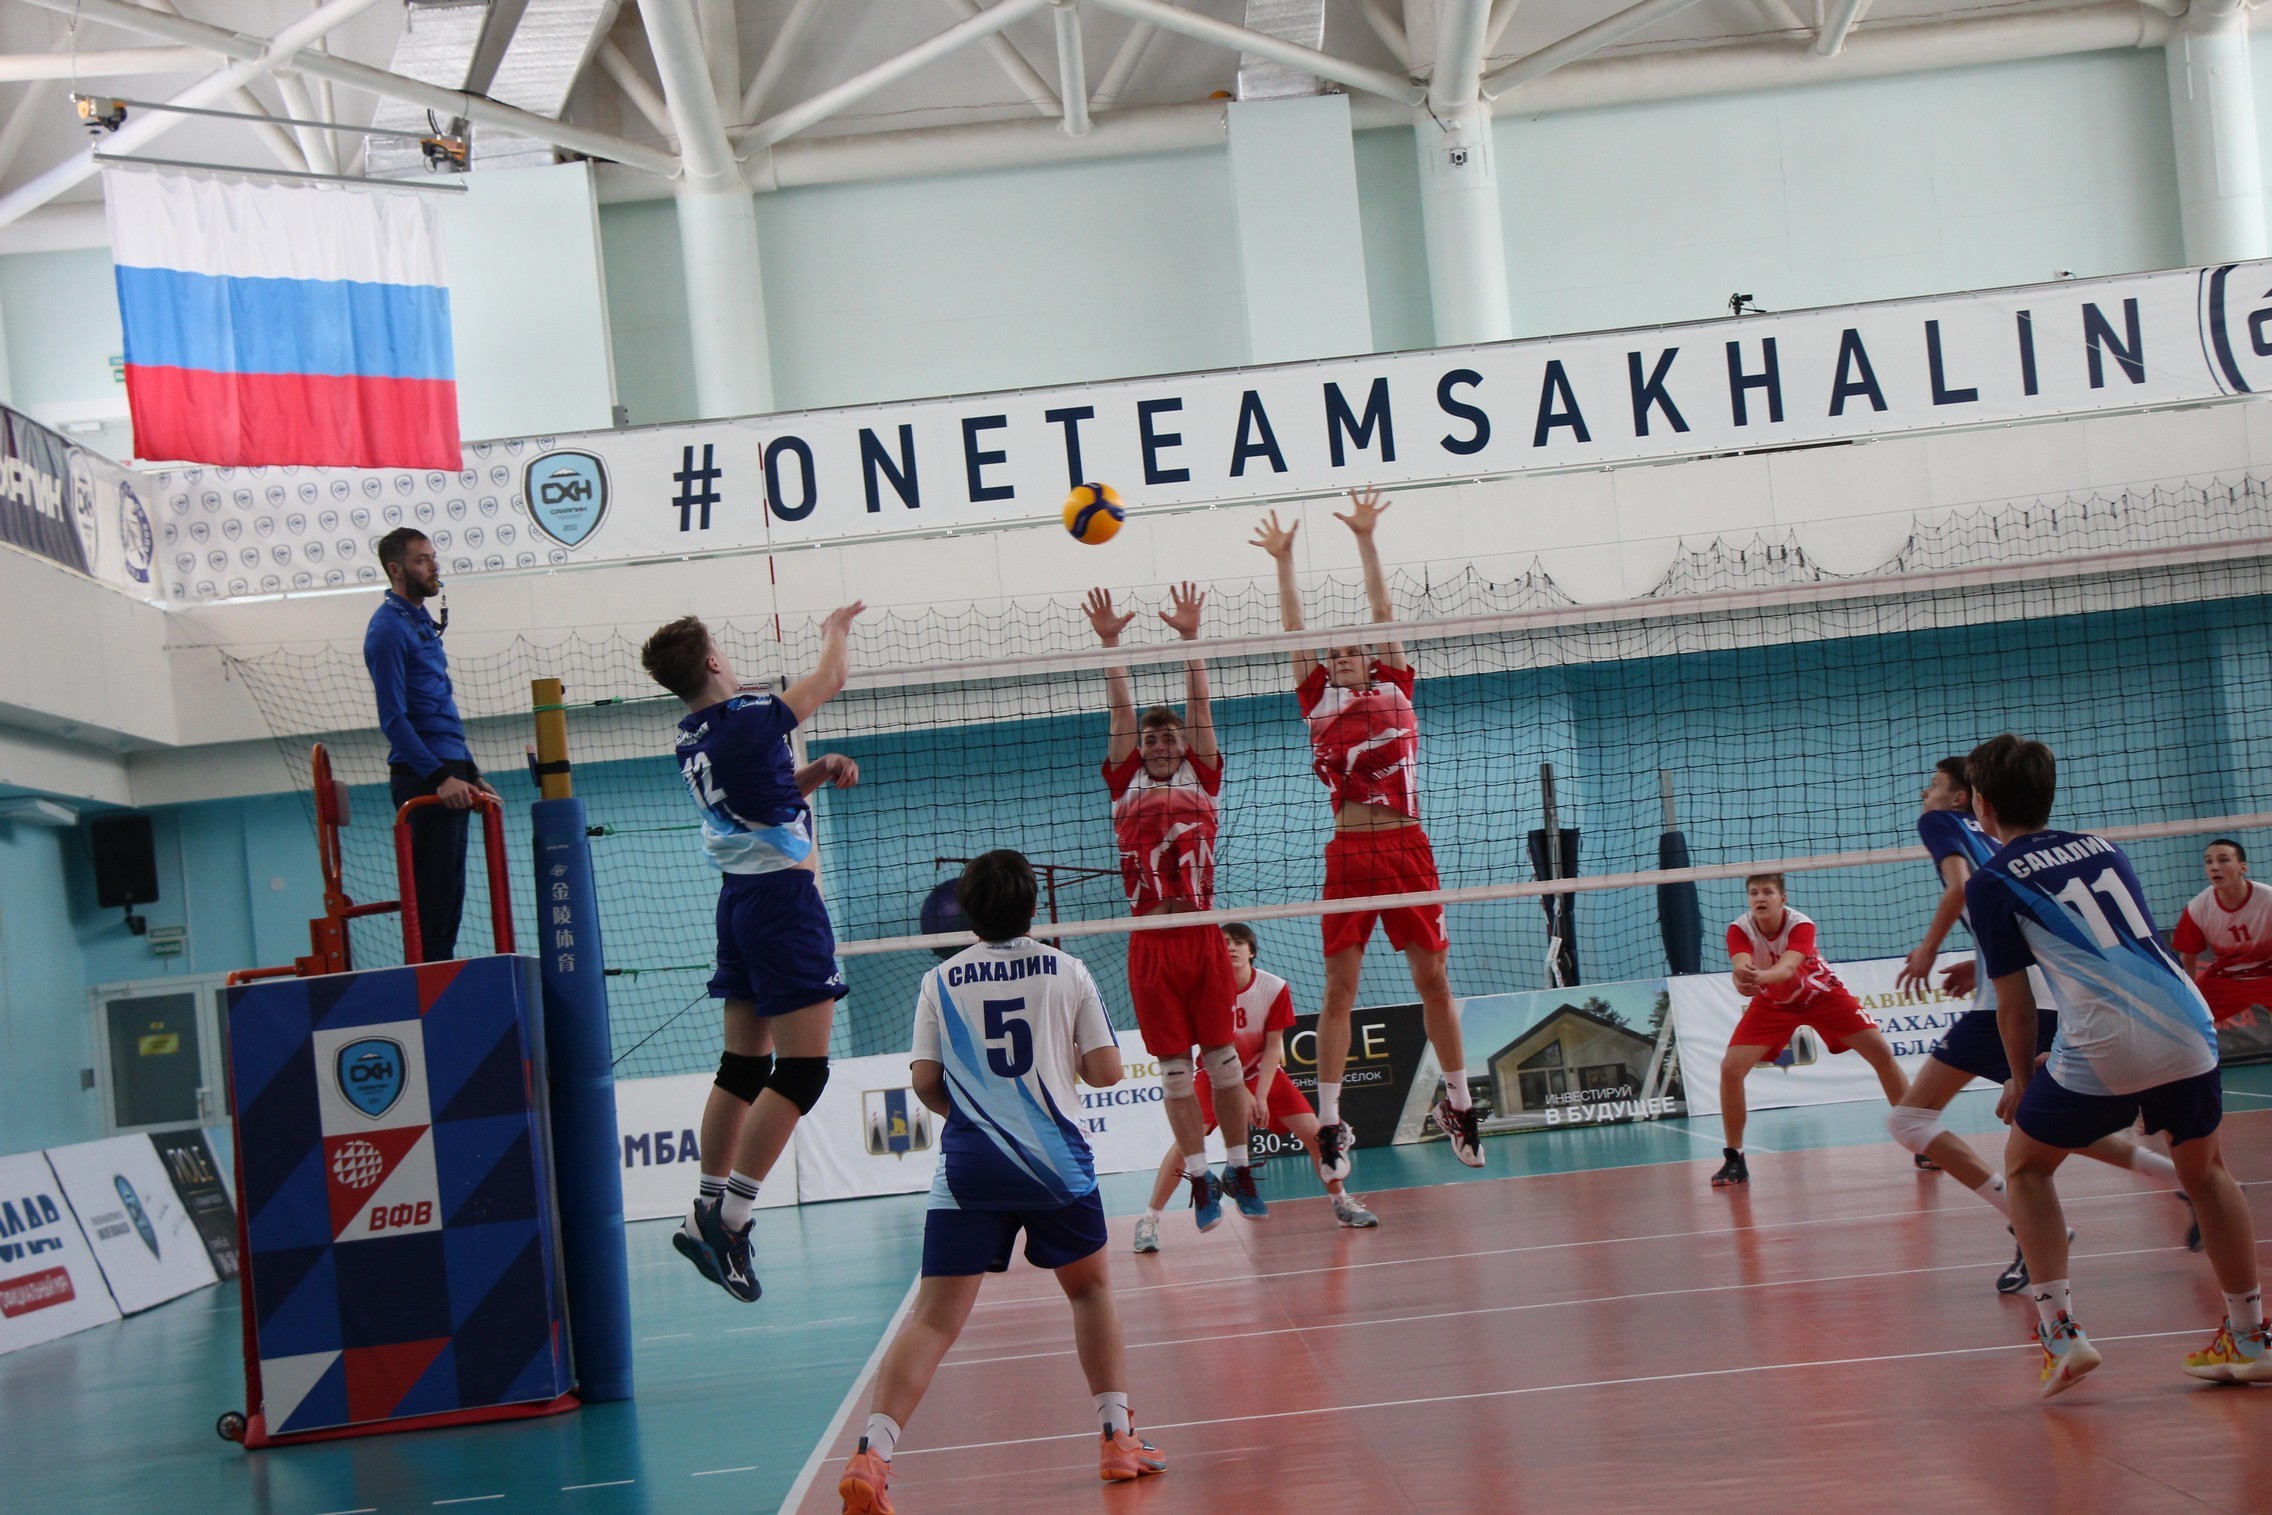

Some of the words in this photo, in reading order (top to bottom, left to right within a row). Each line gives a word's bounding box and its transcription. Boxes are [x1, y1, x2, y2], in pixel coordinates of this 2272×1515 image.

[672, 297, 2146, 532] #ONETEAMSAKHALIN
[2007, 836, 2116, 879] САХАЛИН
[2056, 867, 2152, 949] 11
[2228, 924, 2252, 943] 11
[948, 955, 1058, 988] САХАЛИН
[983, 997, 1034, 1078] 5
[1891, 1038, 1941, 1057] БЛА
[1078, 1086, 1165, 1109] ИНСКО
[1545, 1084, 1633, 1105] ИНВЕСТИРУЙ
[1546, 1108, 1561, 1125] В
[1567, 1096, 1677, 1122] БУДУЩЕЕ
[622, 1128, 702, 1168] МБА
[1252, 1132, 1304, 1154] 30-3
[369, 1200, 433, 1232] ВФВ
